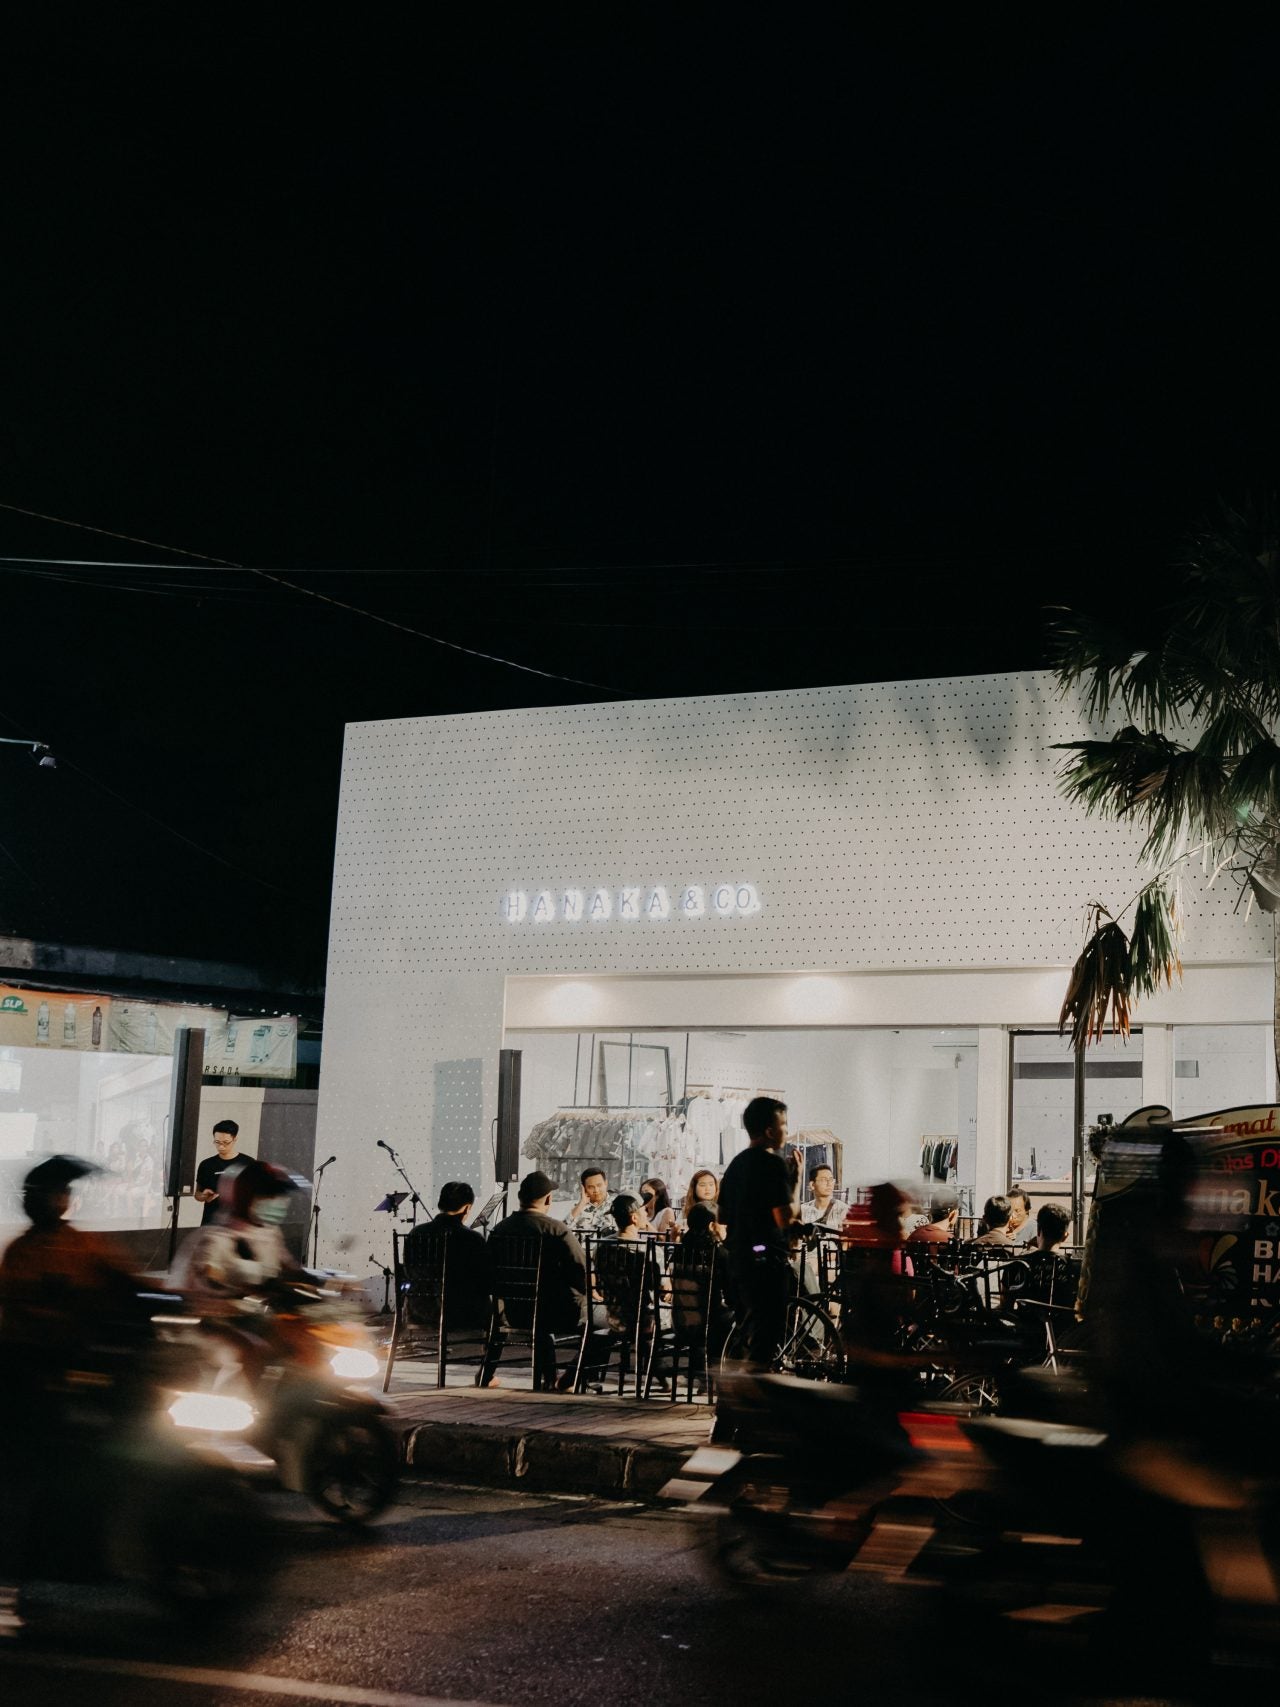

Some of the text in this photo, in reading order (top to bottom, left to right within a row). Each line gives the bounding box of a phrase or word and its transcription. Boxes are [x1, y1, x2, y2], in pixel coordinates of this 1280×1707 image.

[505, 887, 670, 921] HANAKA
[684, 887, 704, 914] &
[4, 999, 23, 1008] SLP
